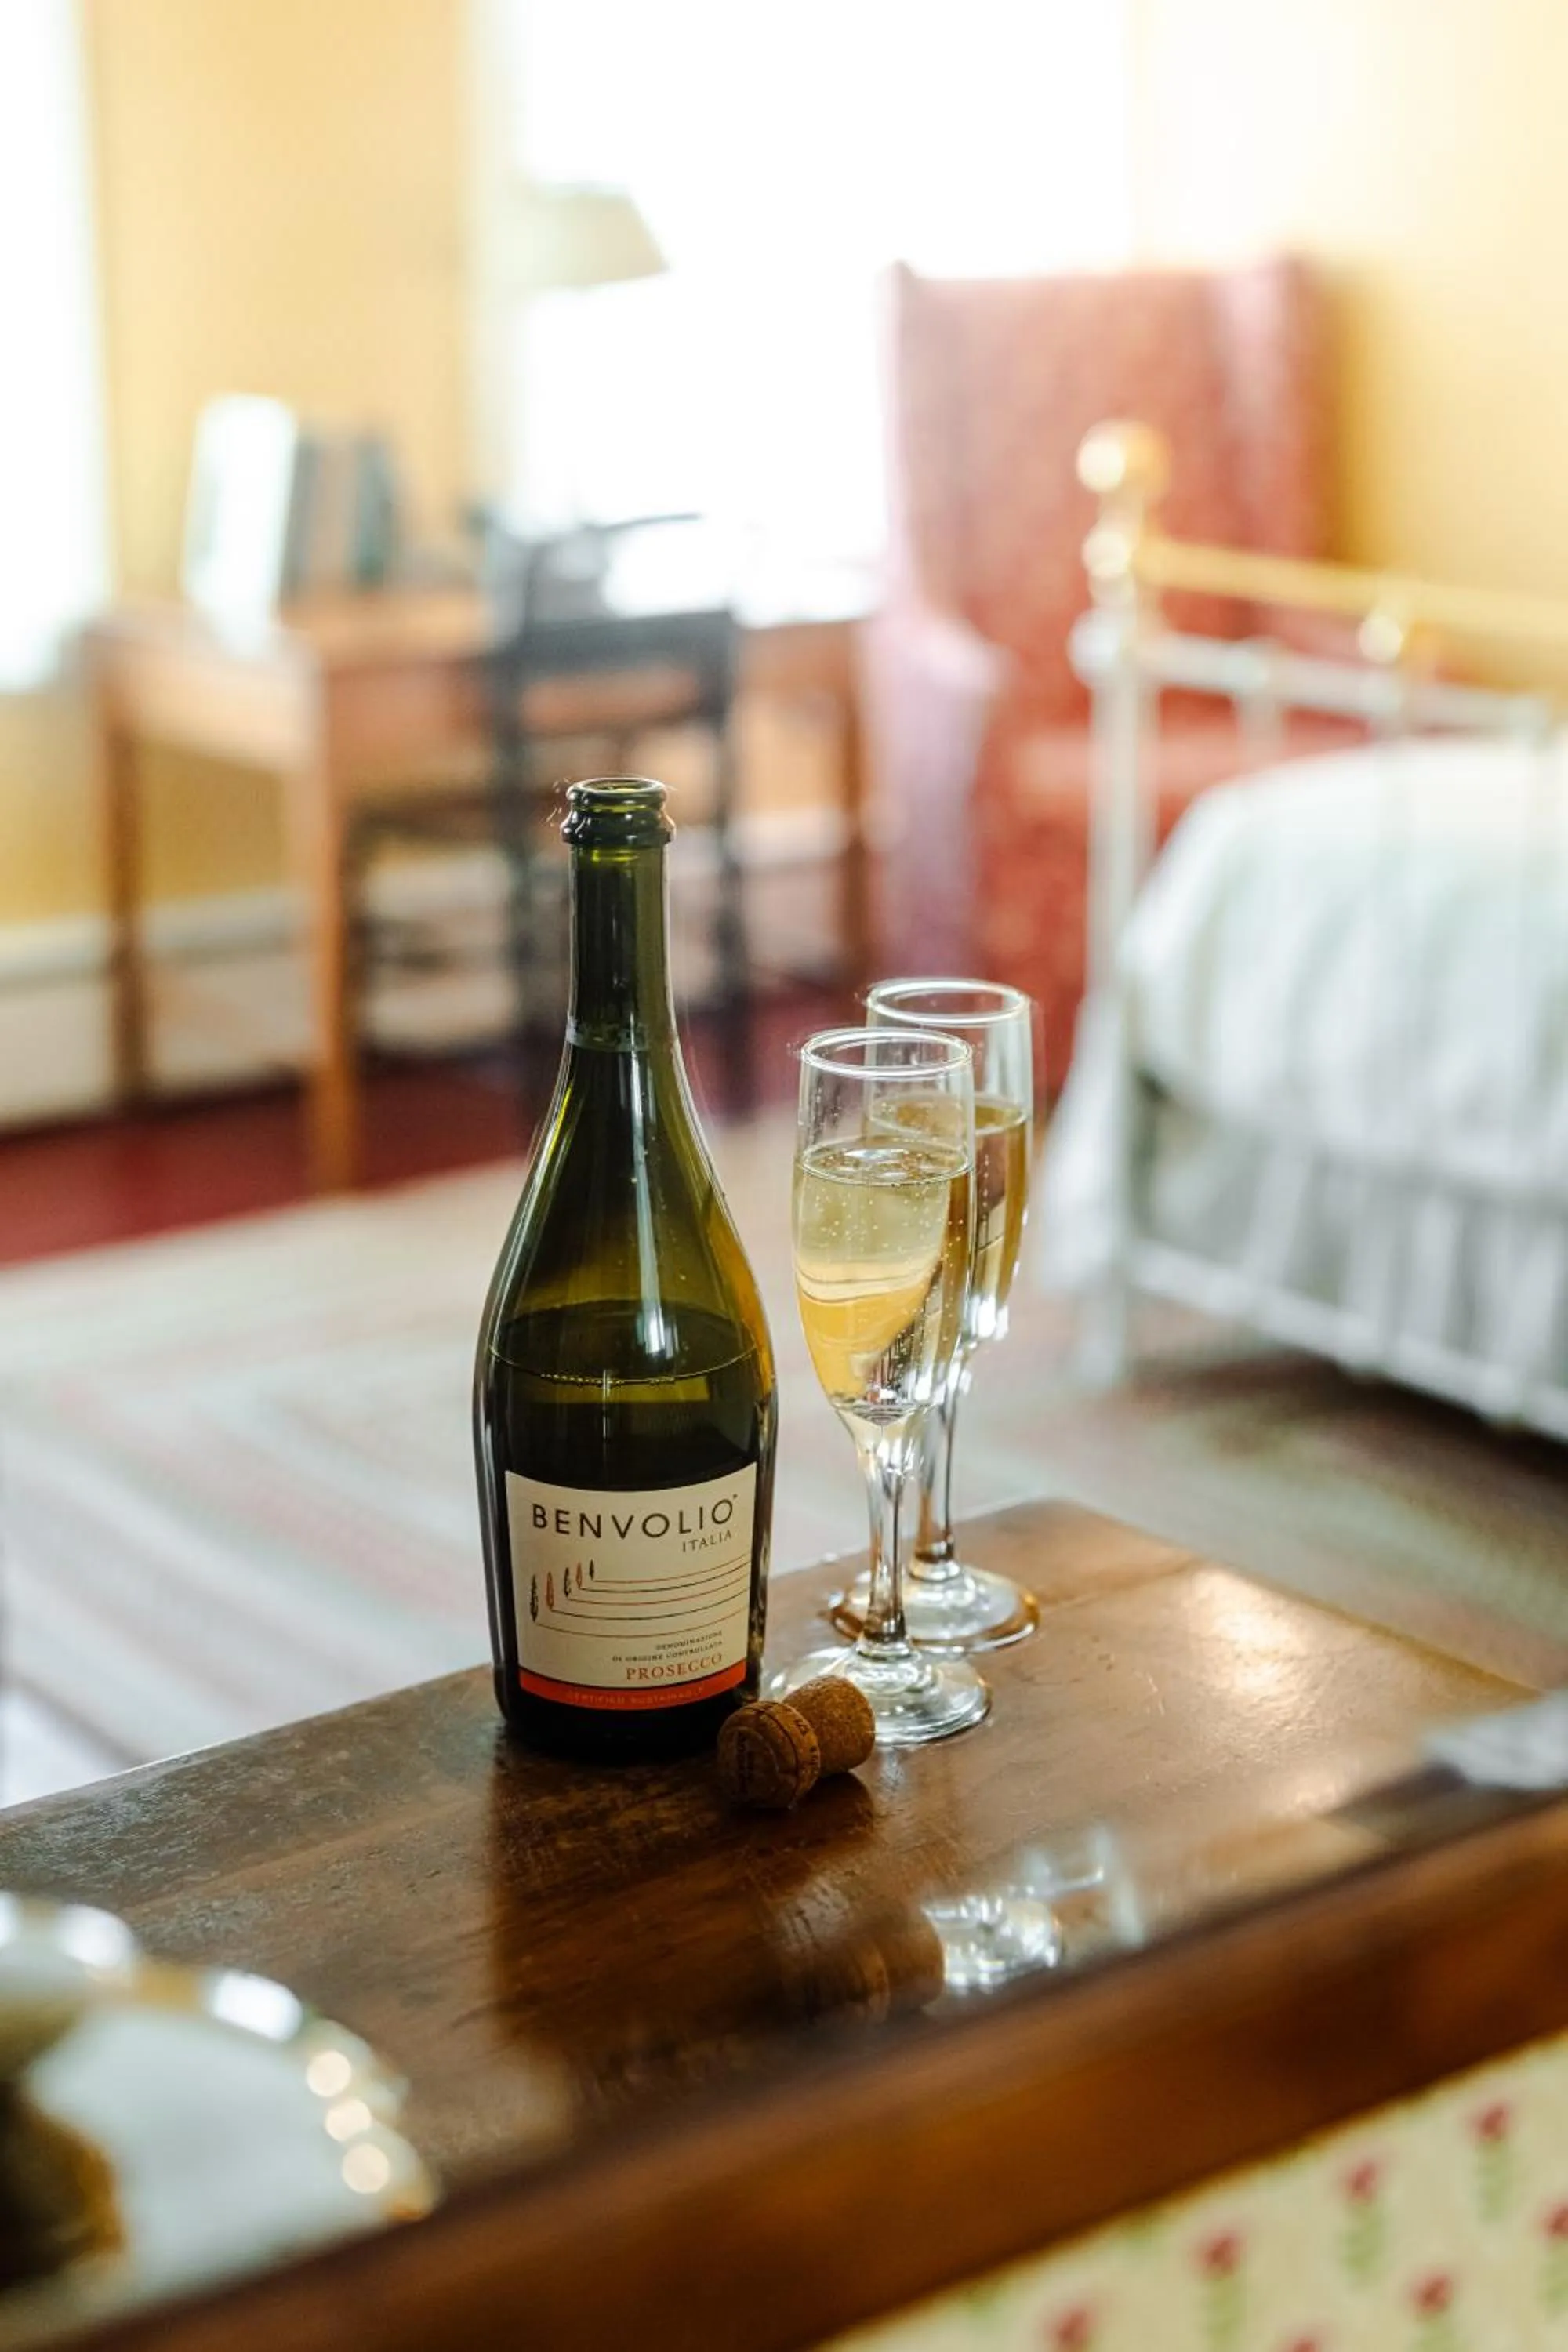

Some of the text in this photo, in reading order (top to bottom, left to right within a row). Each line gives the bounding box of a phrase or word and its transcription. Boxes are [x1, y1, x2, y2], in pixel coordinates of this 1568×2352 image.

[532, 1498, 734, 1540] BENVOLIO
[681, 1529, 733, 1553] ITALIA
[626, 1652, 723, 1681] PROSECCO
